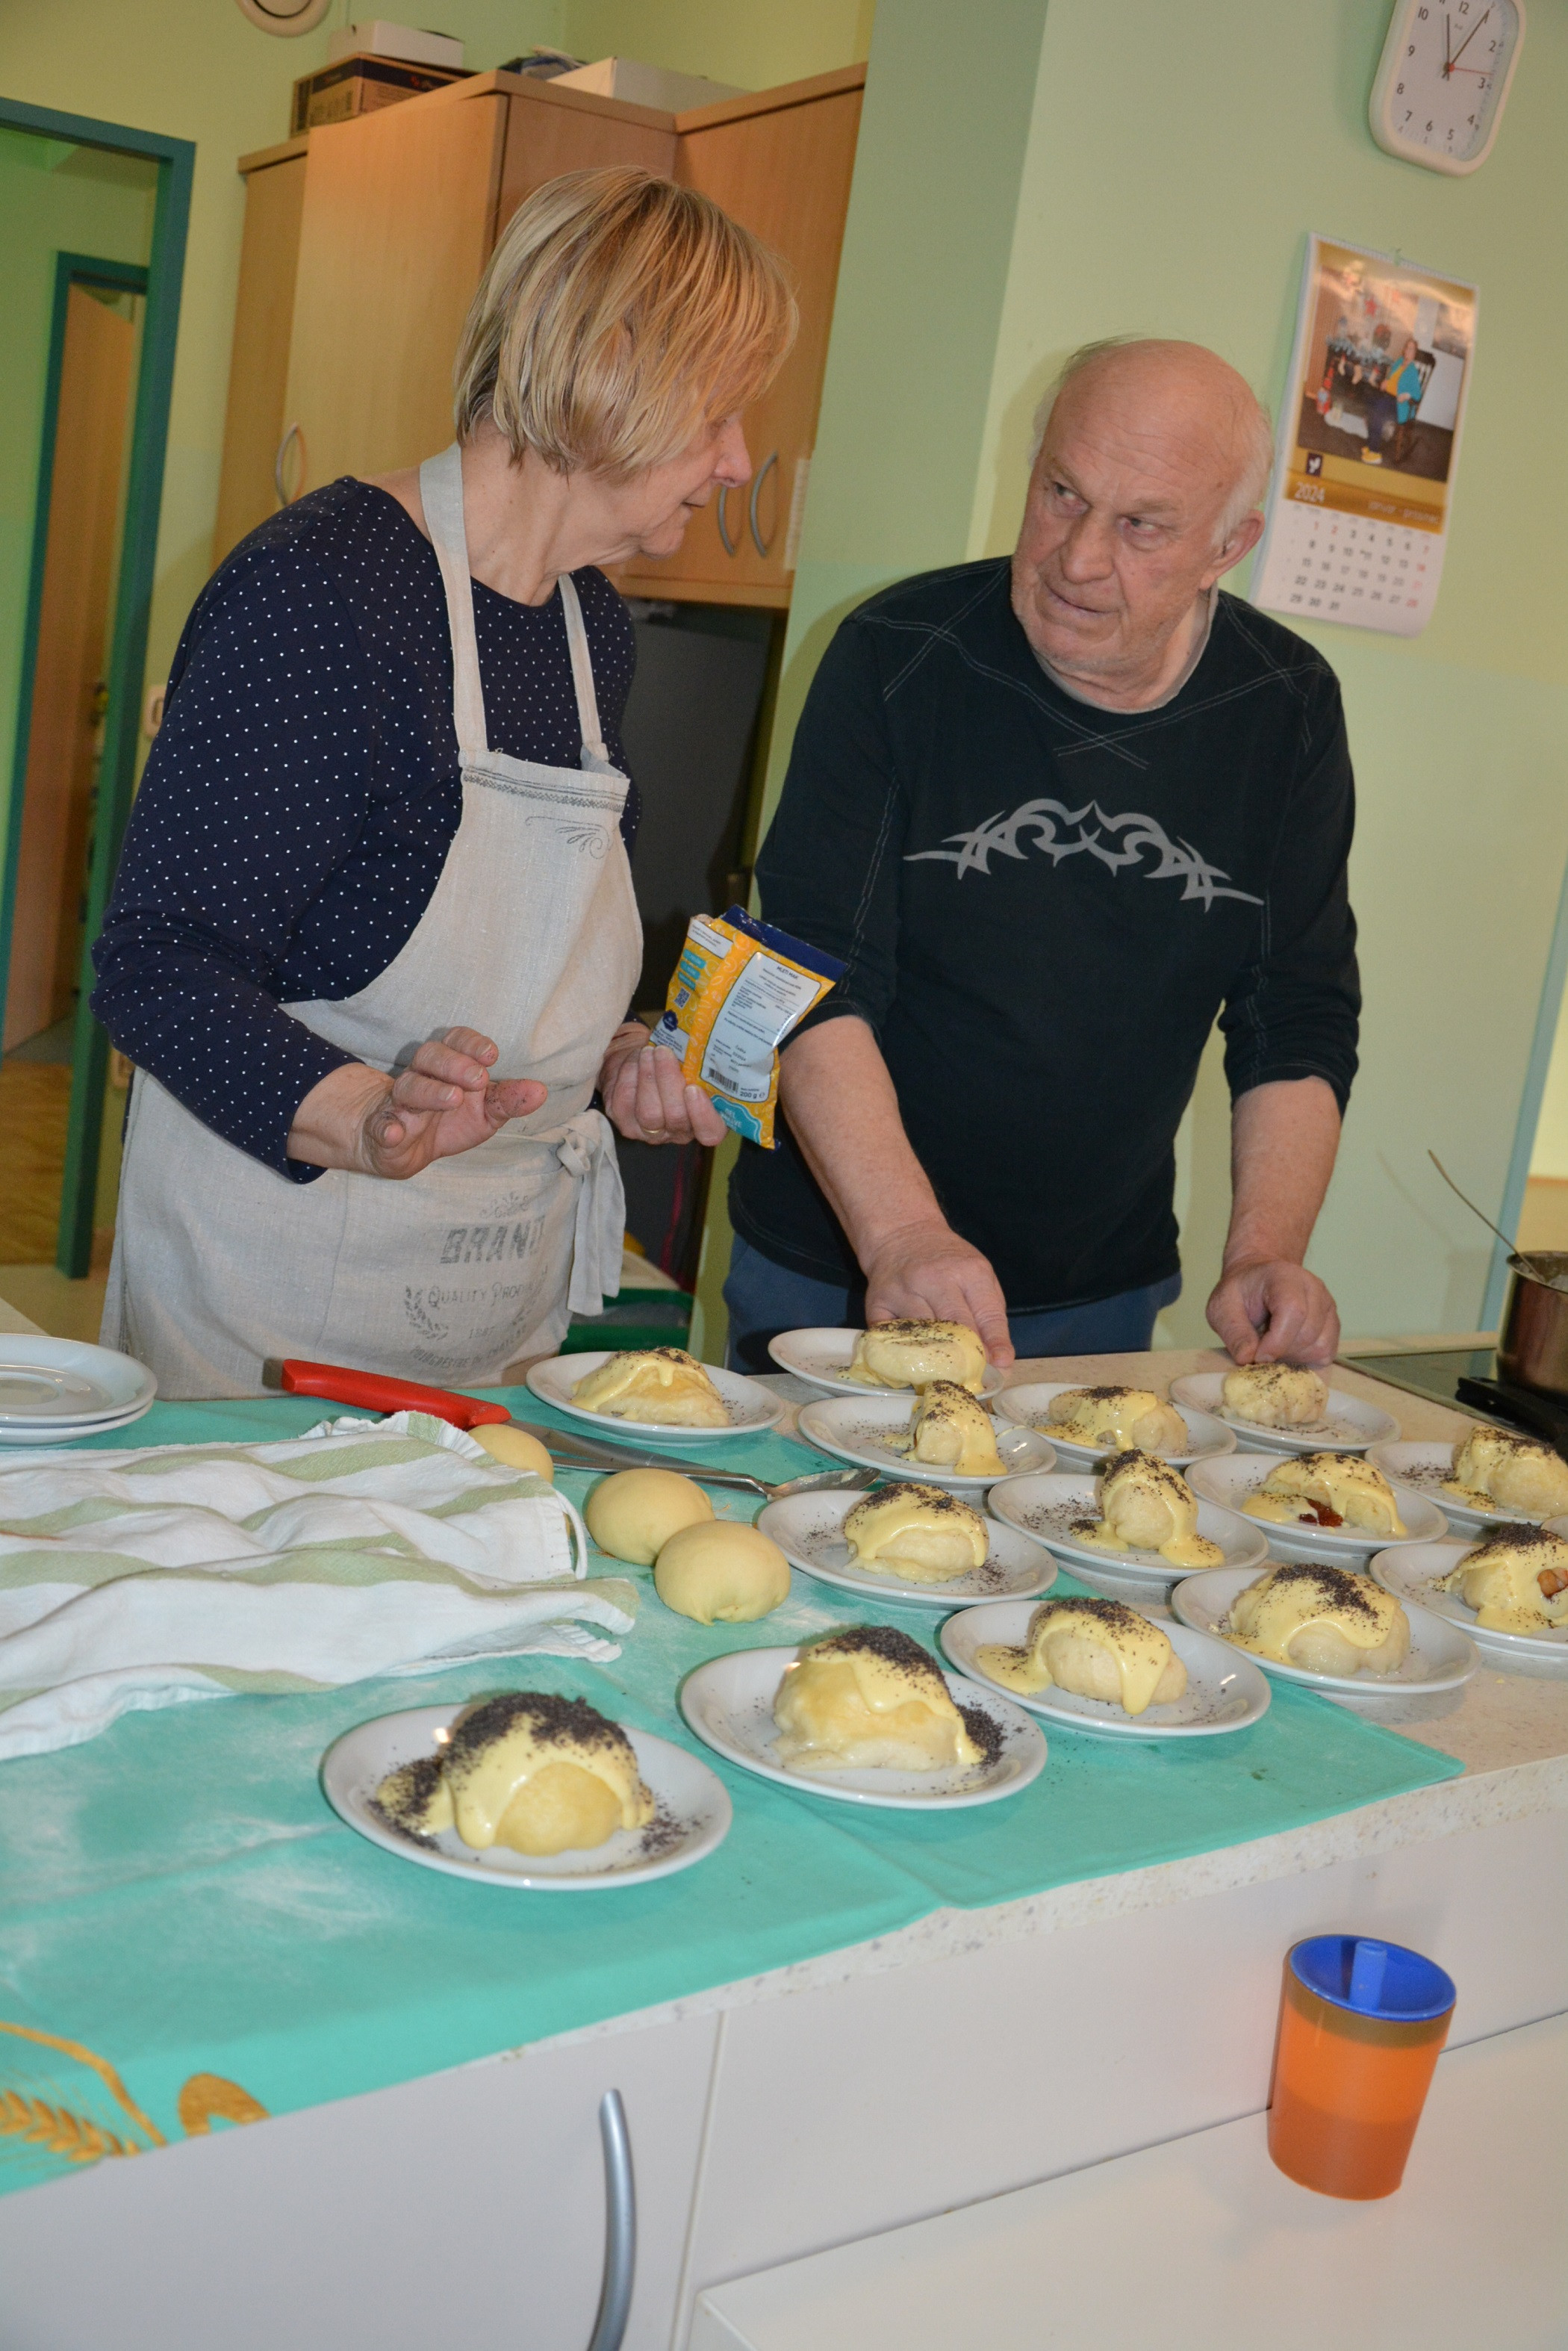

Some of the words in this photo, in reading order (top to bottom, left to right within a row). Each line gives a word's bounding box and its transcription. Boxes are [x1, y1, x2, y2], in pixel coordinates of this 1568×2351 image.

[1418, 7, 1428, 20] 10
[1459, 1, 1469, 14] 12
[1407, 45, 1415, 57] 9
[1489, 40, 1496, 52] 2
[1396, 83, 1404, 95] 8
[1478, 77, 1485, 89] 3
[1405, 111, 1413, 122] 7
[1467, 114, 1475, 125] 4
[1425, 120, 1433, 131] 6
[1447, 128, 1455, 140] 5
[1294, 482, 1325, 503] 2024
[1331, 525, 1338, 535] 2
[1351, 529, 1357, 538] 3
[1387, 538, 1393, 546] 5
[1309, 540, 1316, 549] 8
[1329, 544, 1334, 553] 9
[1344, 547, 1353, 556] 10
[1381, 555, 1391, 565] 12
[1399, 559, 1408, 568] 13
[1417, 563, 1425, 571] 14
[1302, 557, 1311, 568] 15
[1322, 562, 1331, 571] 16
[1341, 565, 1350, 574] 17
[1359, 570, 1368, 579] 18
[1378, 574, 1387, 583] 19
[1393, 577, 1404, 586] 20
[1295, 575, 1307, 586] 22
[1314, 580, 1327, 589] 23
[1333, 583, 1345, 593] 24
[1351, 588, 1363, 597] 25
[1370, 591, 1382, 600] 26
[1389, 594, 1400, 604] 27
[1406, 598, 1418, 608] 28
[1289, 594, 1302, 603] 29
[1308, 597, 1322, 607] 30
[1328, 601, 1340, 610] 31
[428, 1285, 486, 1309] QUALITY
